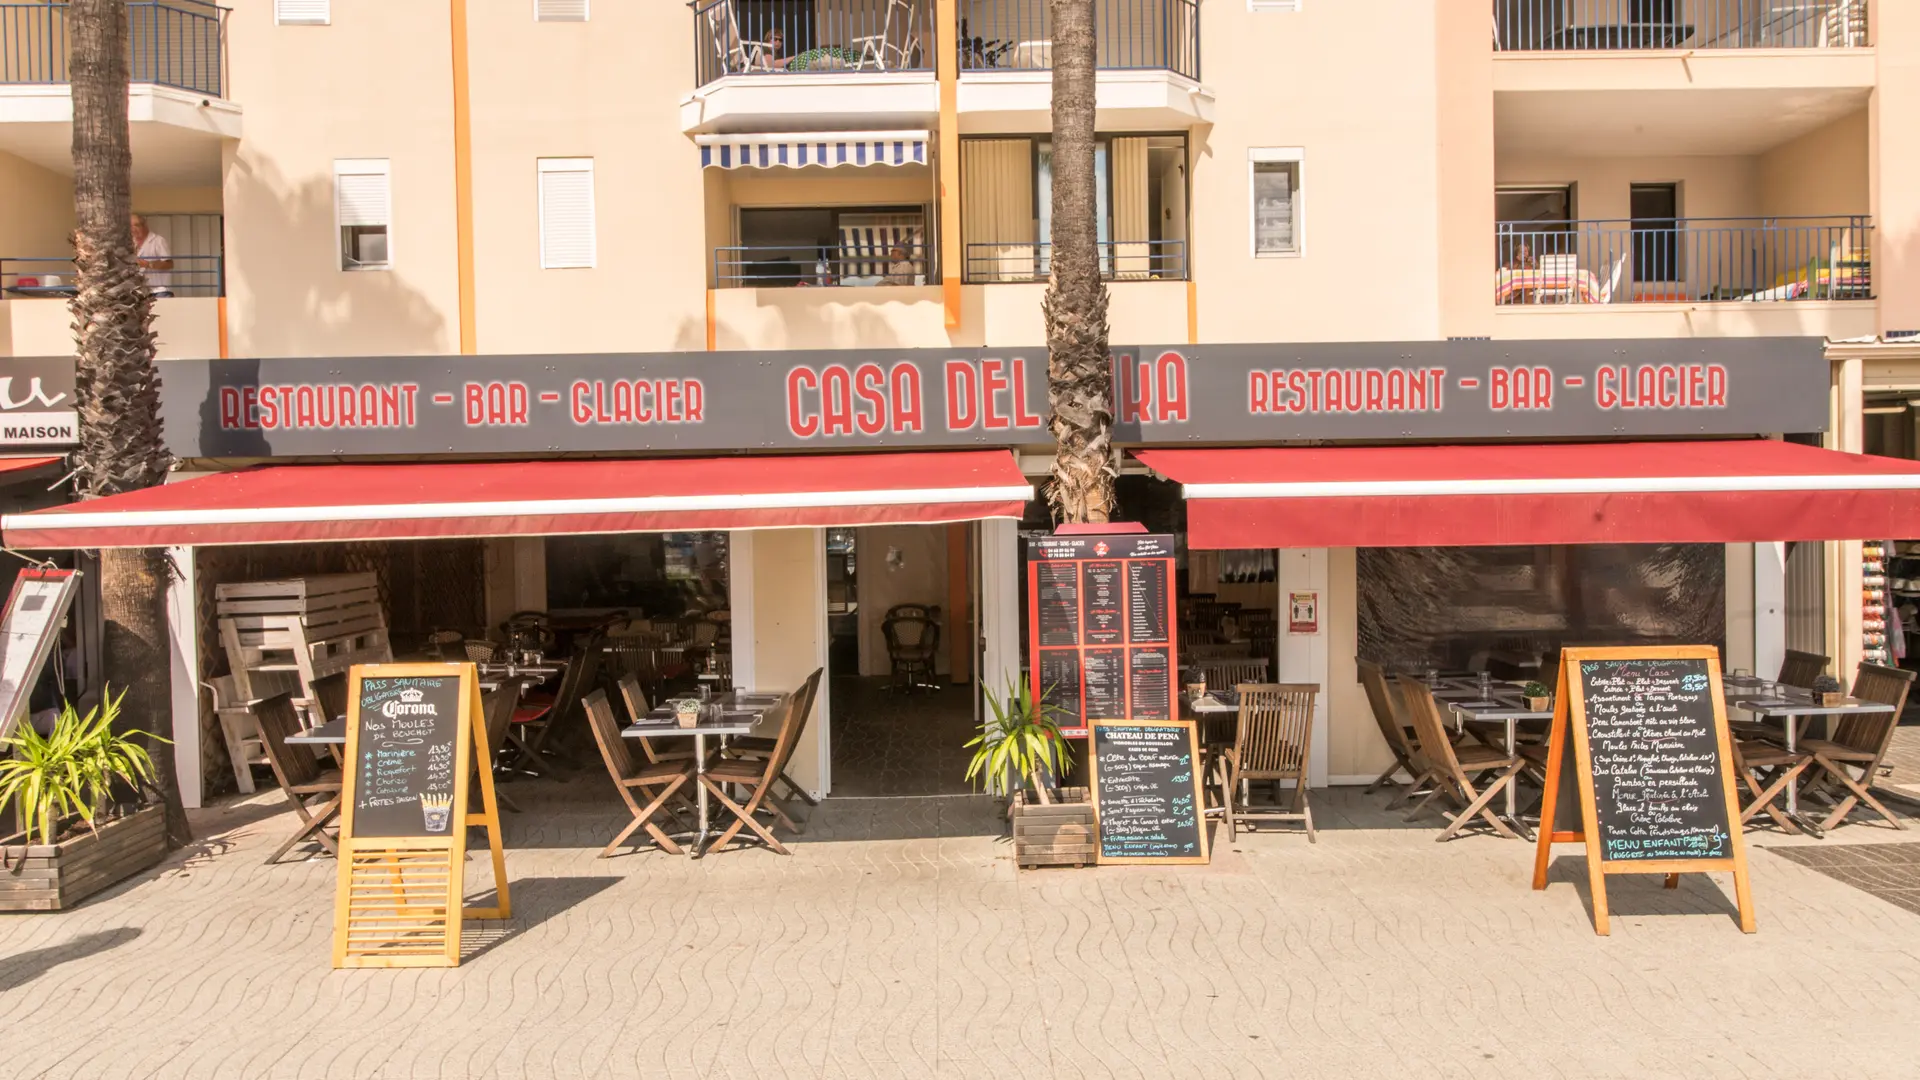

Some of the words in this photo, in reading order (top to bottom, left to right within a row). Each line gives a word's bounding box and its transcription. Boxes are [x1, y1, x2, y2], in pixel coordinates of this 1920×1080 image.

[1249, 368, 1446, 414] RESTAURANT
[1490, 367, 1552, 410] BAR
[1597, 364, 1727, 409] GLACIER
[219, 384, 419, 430] RESTAURANT
[464, 382, 529, 425] BAR
[571, 379, 704, 424] GLACIER
[787, 362, 923, 437] CASA
[946, 359, 1041, 430] DEL
[4, 426, 72, 439] MAISON
[1581, 662, 1599, 675] PASS
[1612, 664, 1641, 677] Menu
[364, 679, 387, 692] PASS
[1594, 704, 1619, 715] Moules
[391, 718, 435, 730] MOULES
[1105, 732, 1143, 740] CHATEAU
[1144, 732, 1157, 740] DE
[1157, 732, 1180, 740] PENA
[1603, 741, 1628, 751] Moules
[1593, 765, 1609, 776] Duo
[1607, 839, 1640, 850] MENU
[1642, 837, 1683, 849] ENFANT
